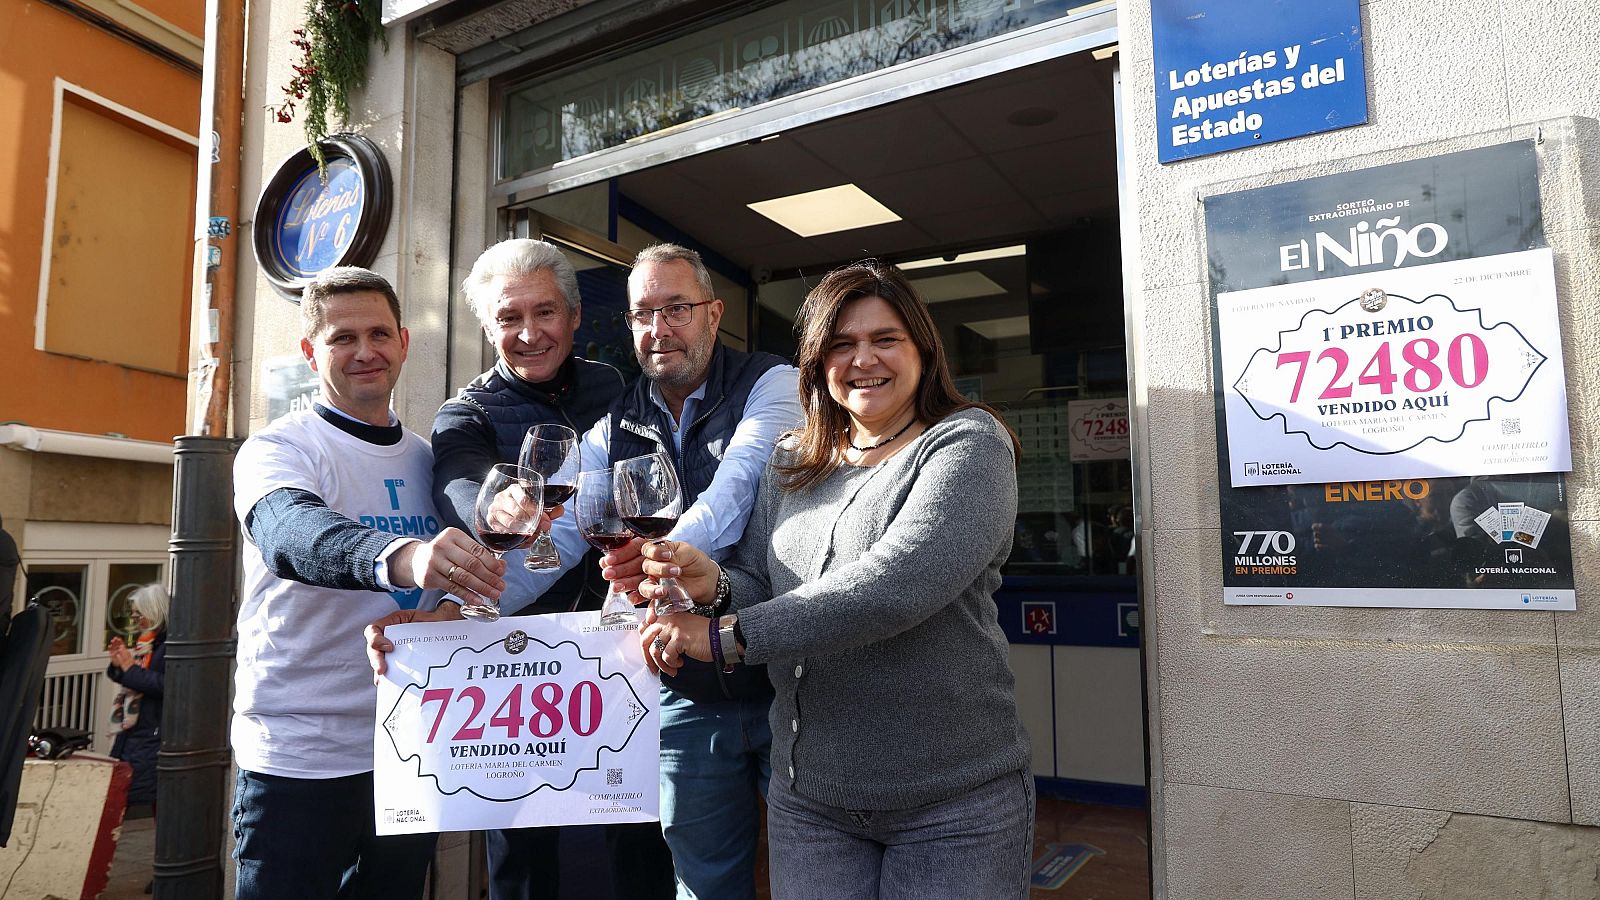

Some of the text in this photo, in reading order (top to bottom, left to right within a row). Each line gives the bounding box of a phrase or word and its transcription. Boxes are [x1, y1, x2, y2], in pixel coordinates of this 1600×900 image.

[1168, 44, 1301, 91] Loterías y
[1171, 58, 1345, 120] Apuestas del
[1171, 110, 1263, 147] Estado
[1308, 199, 1410, 222] EXTRAORDINARIO DE
[1336, 198, 1375, 212] SORTEO
[333, 213, 352, 249] 6
[1315, 215, 1449, 272] Niño
[1453, 277, 1463, 285] 22
[1480, 268, 1532, 281] DICIEMBRE
[1340, 315, 1434, 339] PREMIO
[1275, 332, 1489, 404] 72480
[1317, 391, 1449, 416] VENDIDO AQUÍ
[1082, 418, 1128, 437] 7248
[1362, 424, 1405, 434] LOGROÑO
[1262, 468, 1302, 476] NACIONAL
[1324, 479, 1430, 502] ENERO
[359, 515, 440, 536] PREMIO
[1233, 530, 1296, 555] 770
[1234, 556, 1297, 566] MILLONES
[1235, 566, 1297, 575] EN PREMIOS
[434, 634, 468, 642] NAVIDAD
[603, 624, 639, 632] DICIEMBR
[482, 660, 562, 679] PREMIO
[420, 680, 603, 744] 72480
[449, 737, 567, 758] VENDIDO AQUÍ
[528, 759, 563, 767] CARMEN
[486, 769, 525, 779] LOGROÑO
[588, 791, 643, 801] COMPARTIRLO
